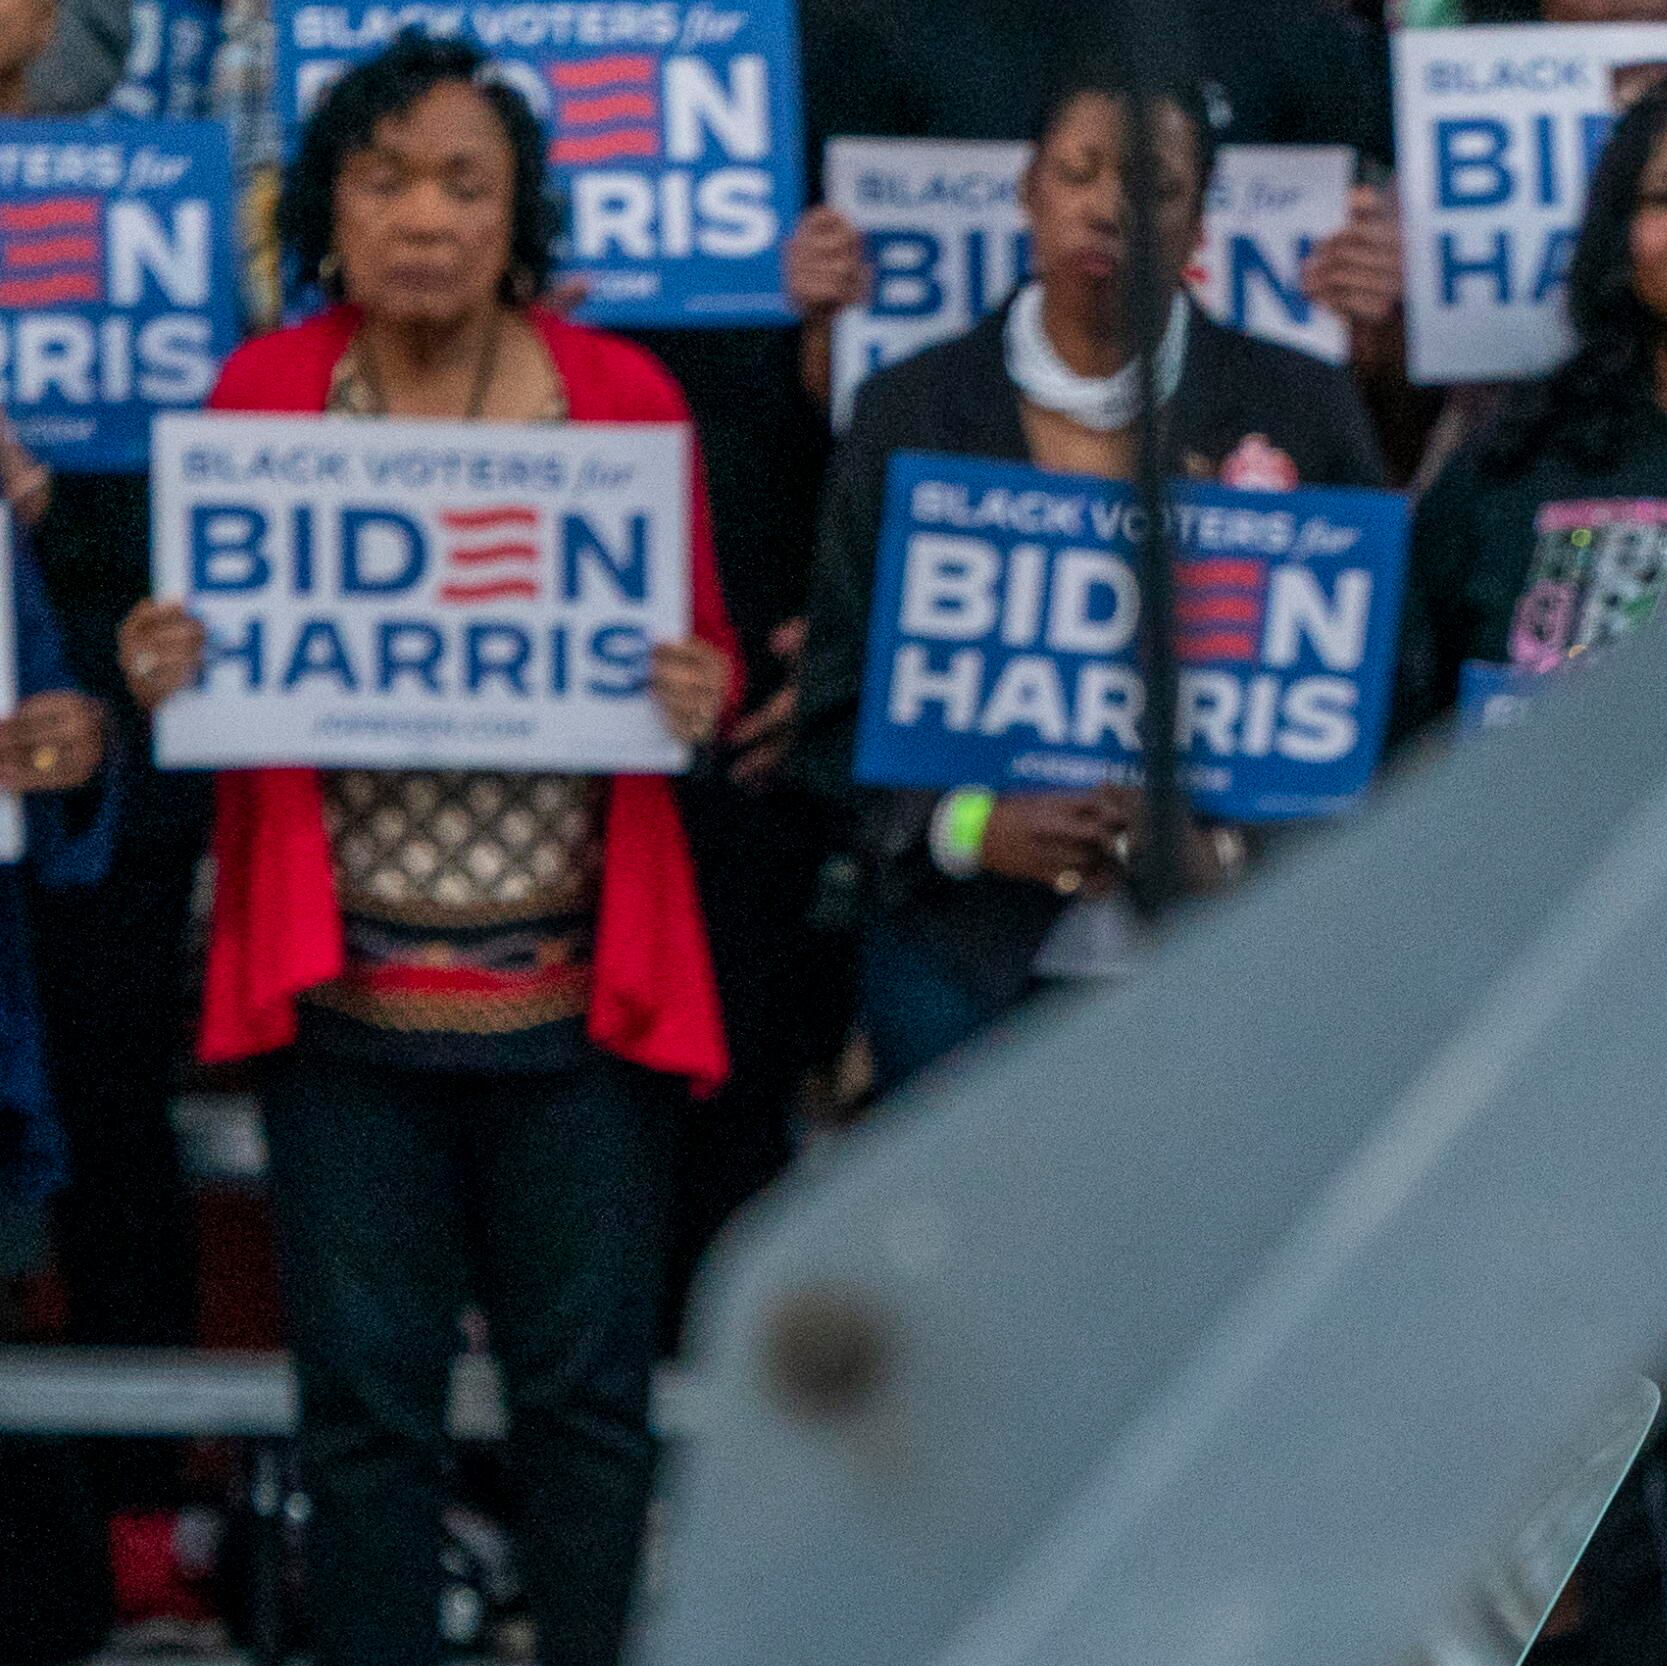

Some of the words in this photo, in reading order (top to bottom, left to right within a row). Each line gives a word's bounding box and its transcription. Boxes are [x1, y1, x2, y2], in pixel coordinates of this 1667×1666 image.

[552, 170, 780, 259] RIS
[184, 445, 348, 486] BLACK
[363, 450, 566, 489] VOTERS
[912, 479, 1086, 532] BLACK
[192, 503, 648, 605] BIDEN
[900, 531, 1374, 672] BIDEN
